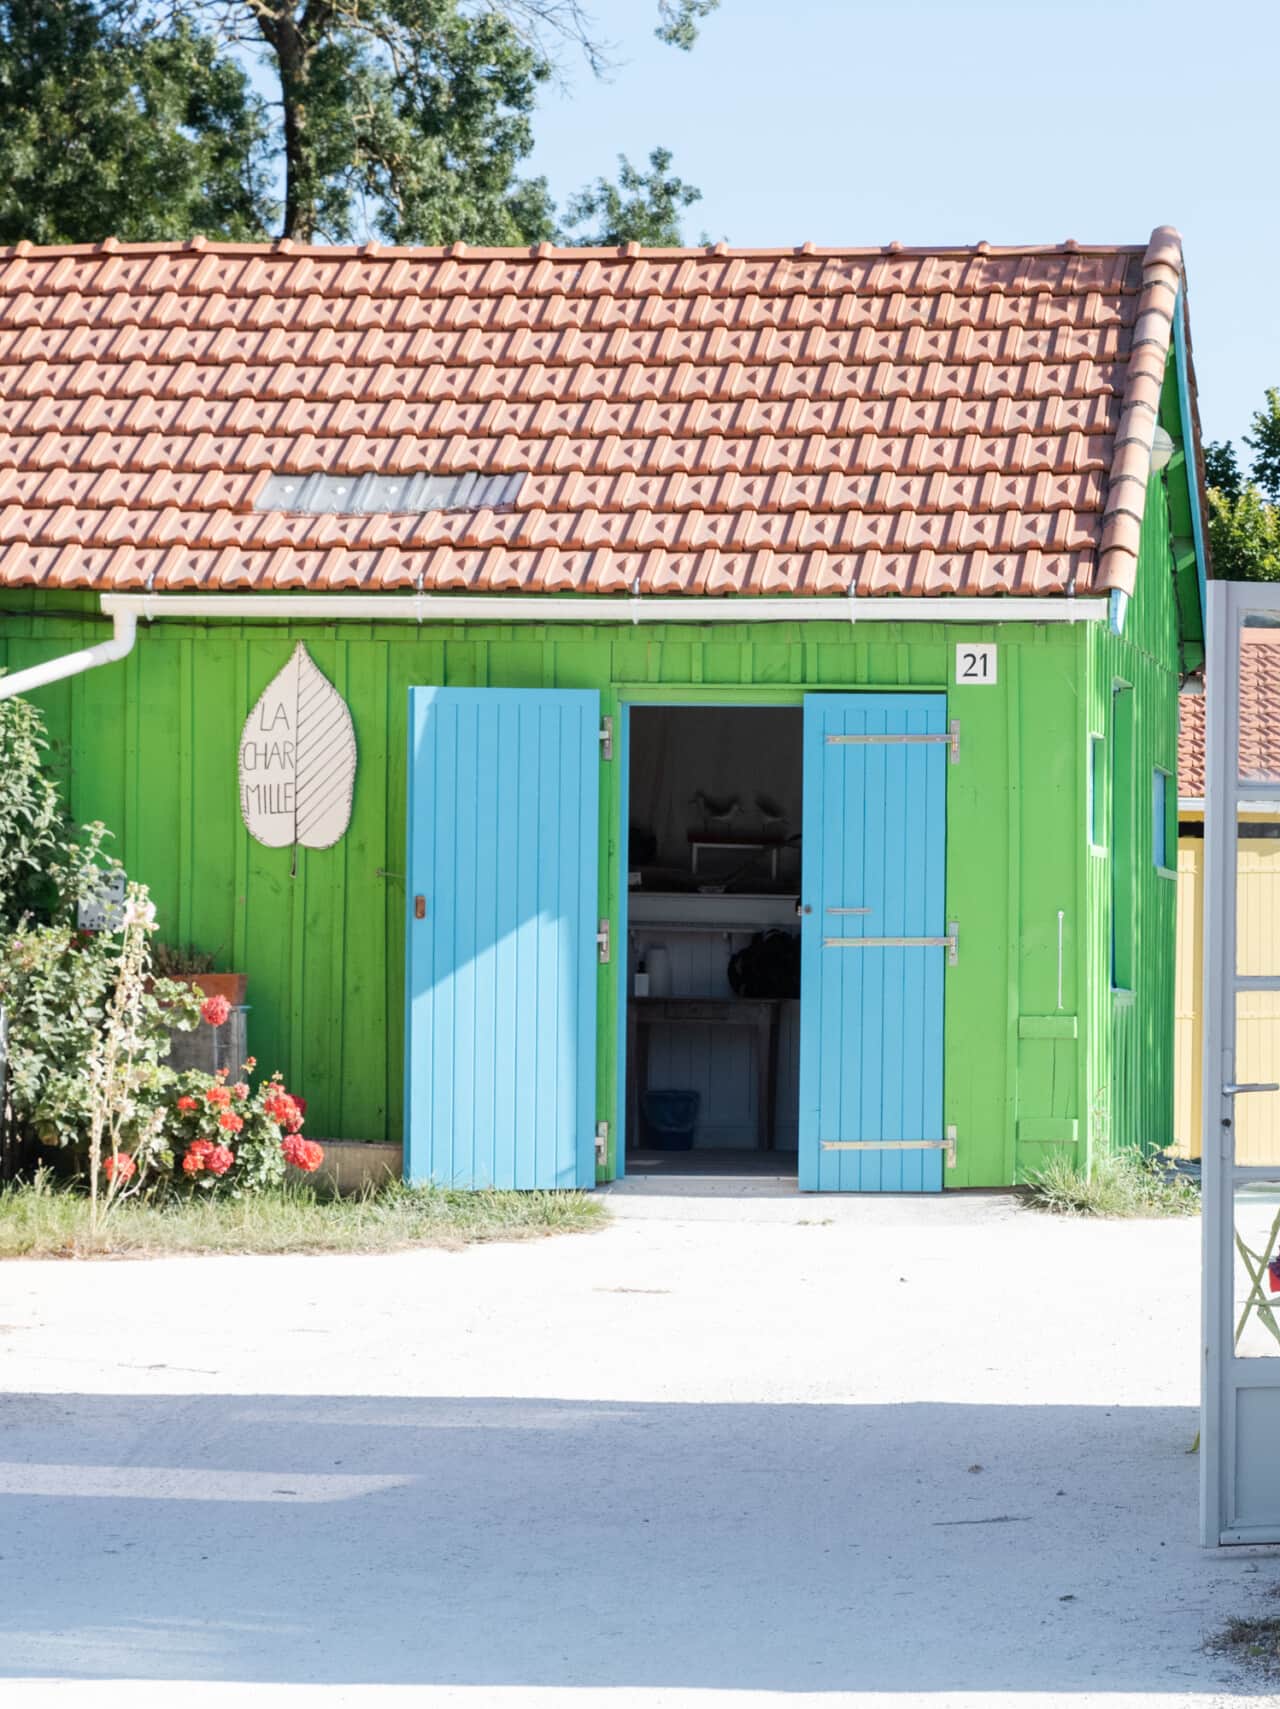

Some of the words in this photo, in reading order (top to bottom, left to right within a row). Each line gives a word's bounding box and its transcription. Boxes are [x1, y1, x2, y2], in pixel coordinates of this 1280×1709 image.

[962, 653, 987, 677] 21
[260, 702, 290, 731] LA
[243, 741, 294, 770] CHAR
[244, 783, 295, 815] MILLE
